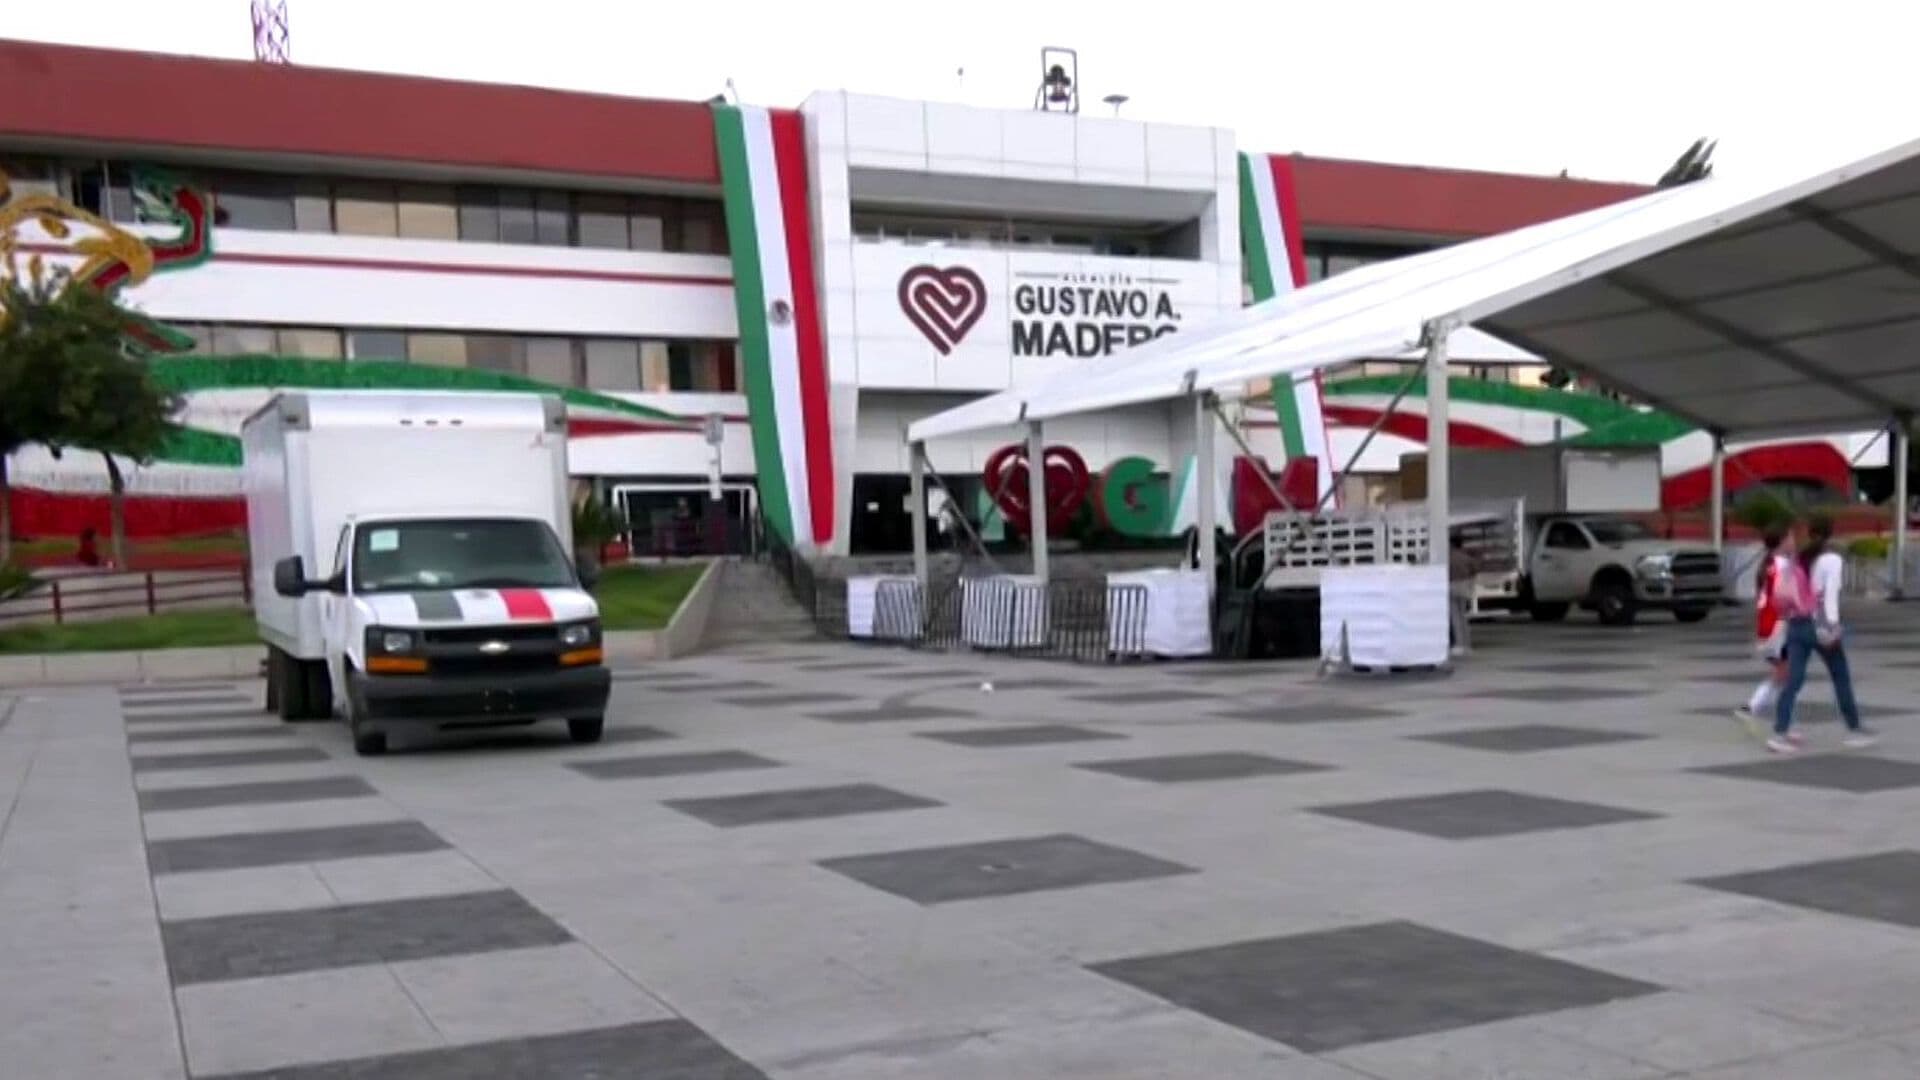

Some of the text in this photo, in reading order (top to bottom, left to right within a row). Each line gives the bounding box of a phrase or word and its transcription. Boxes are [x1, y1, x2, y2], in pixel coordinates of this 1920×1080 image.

[1015, 284, 1182, 320] GUSTAVO A.
[1012, 320, 1178, 357] MADER
